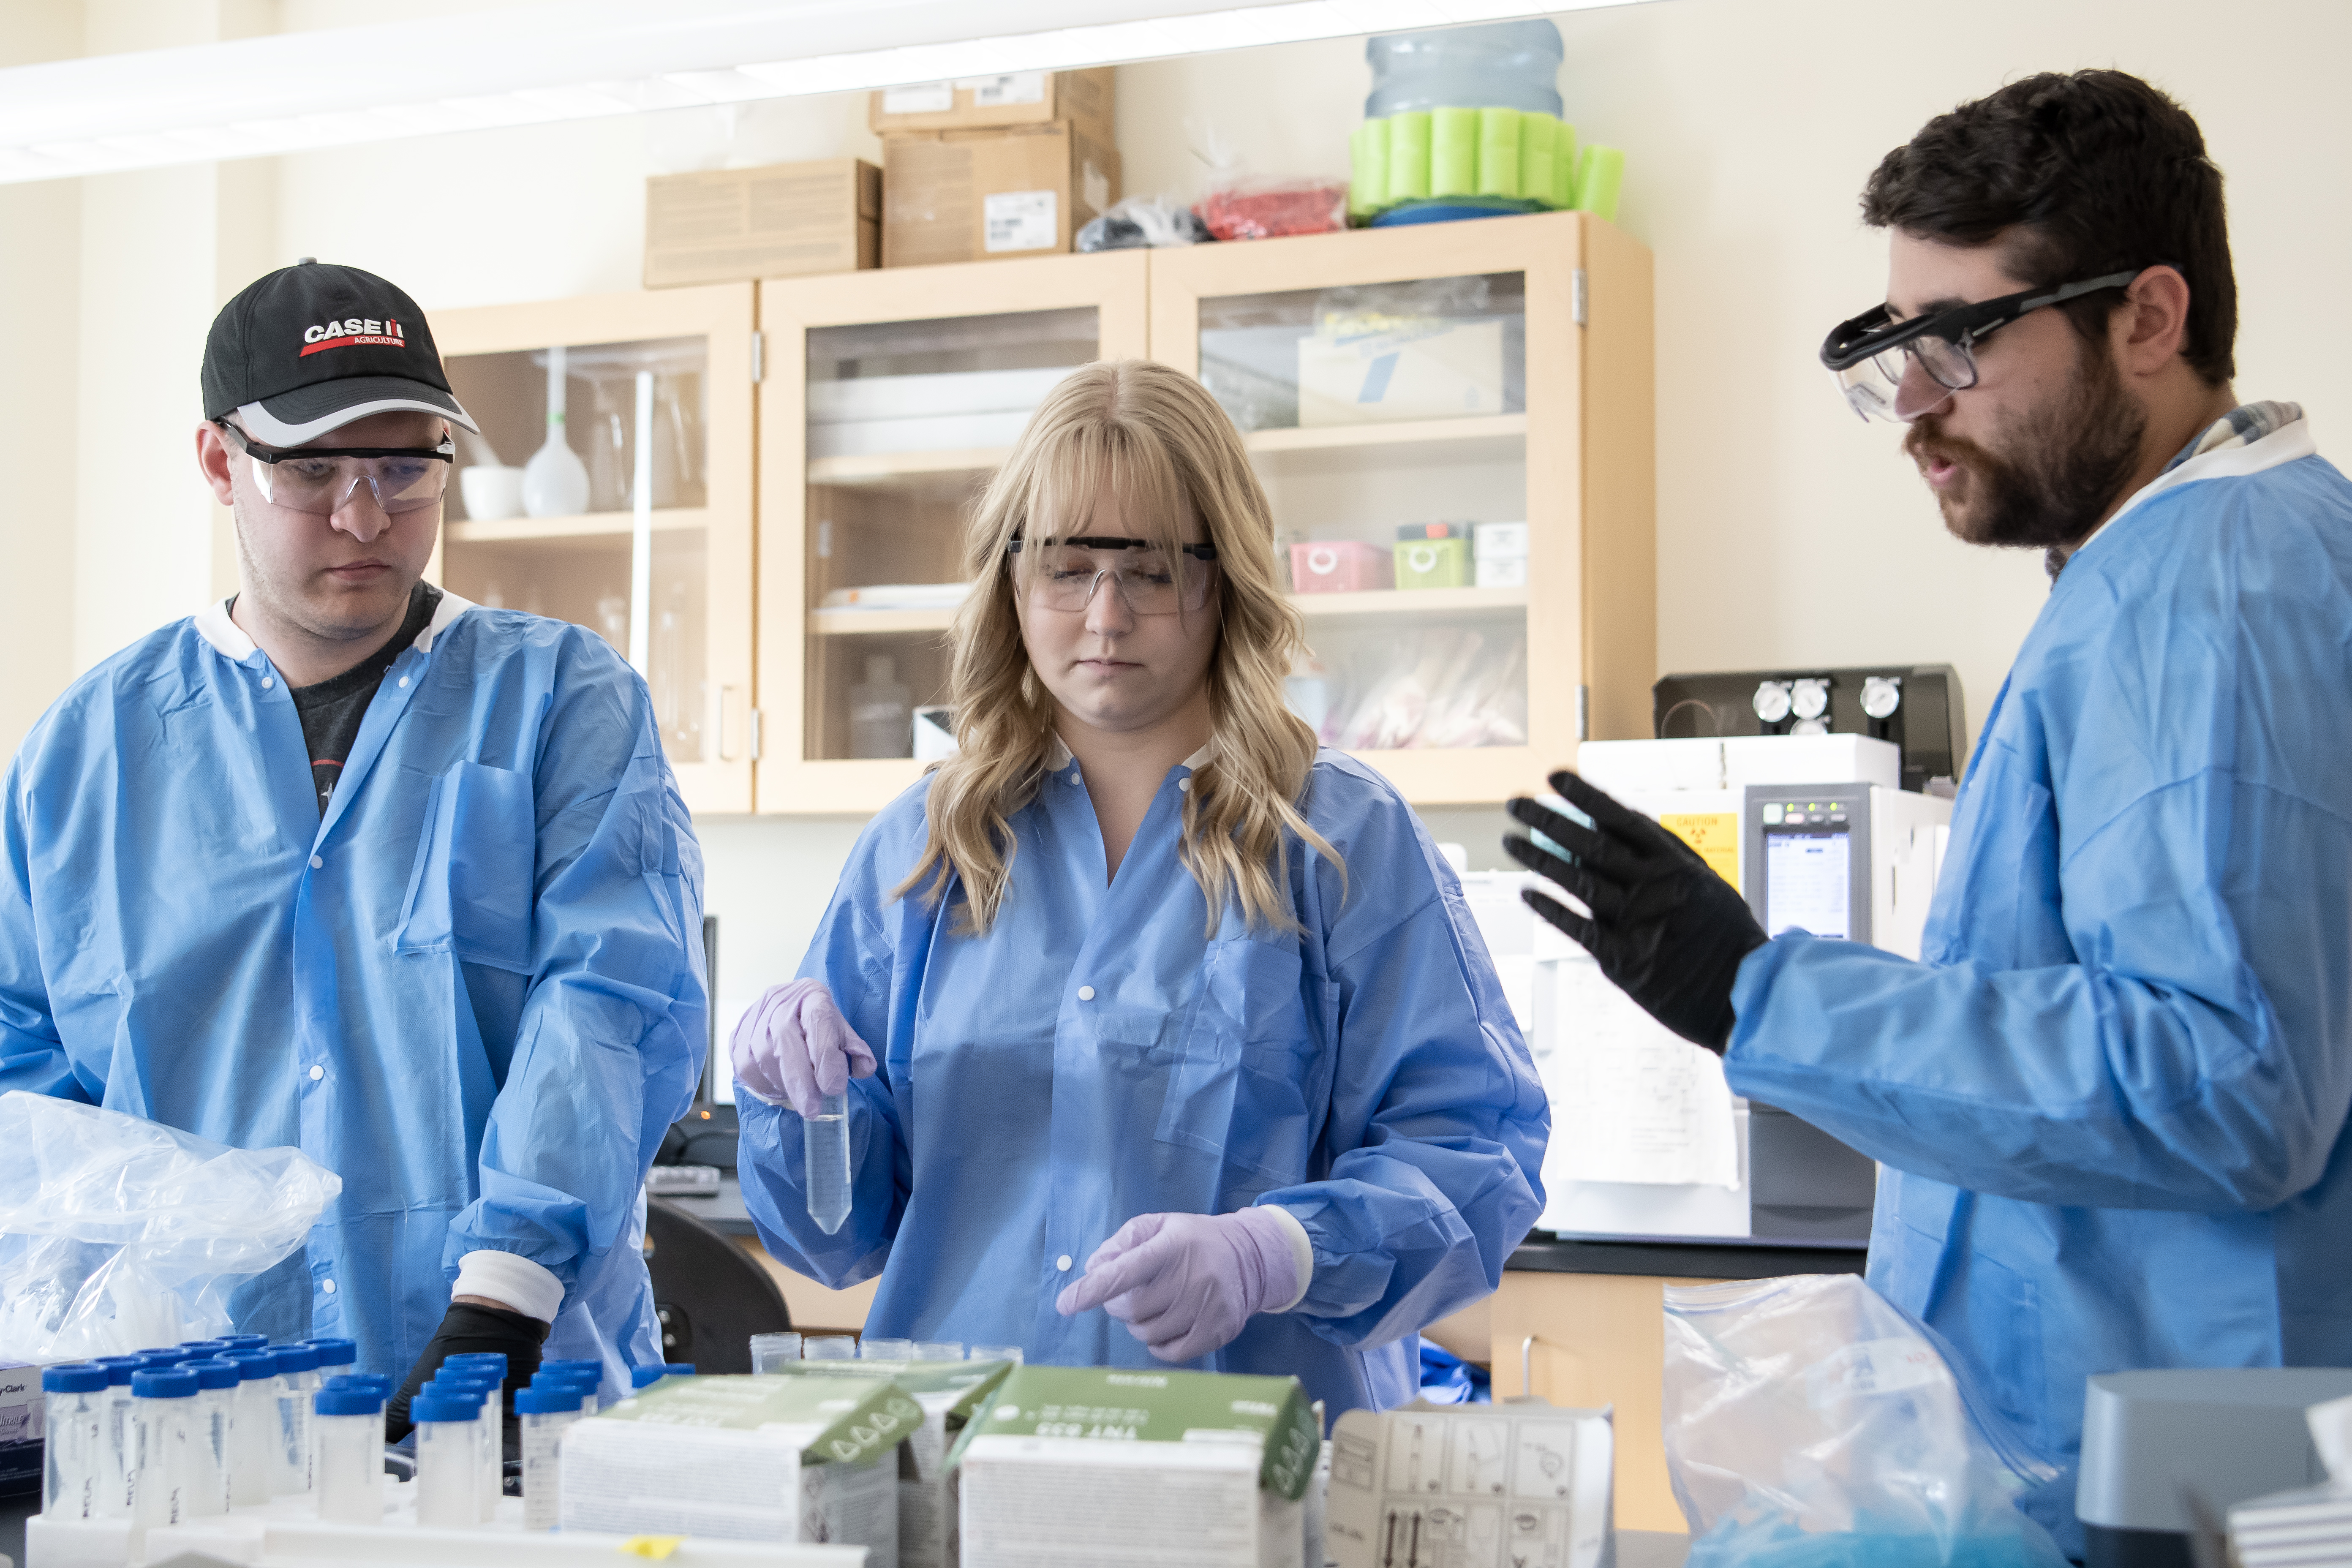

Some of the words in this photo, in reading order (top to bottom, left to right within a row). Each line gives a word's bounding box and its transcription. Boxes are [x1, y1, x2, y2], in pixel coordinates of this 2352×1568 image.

[305, 318, 382, 343] CASE
[354, 337, 404, 347] AGRICULTURE
[1676, 817, 1718, 827] CAUTION
